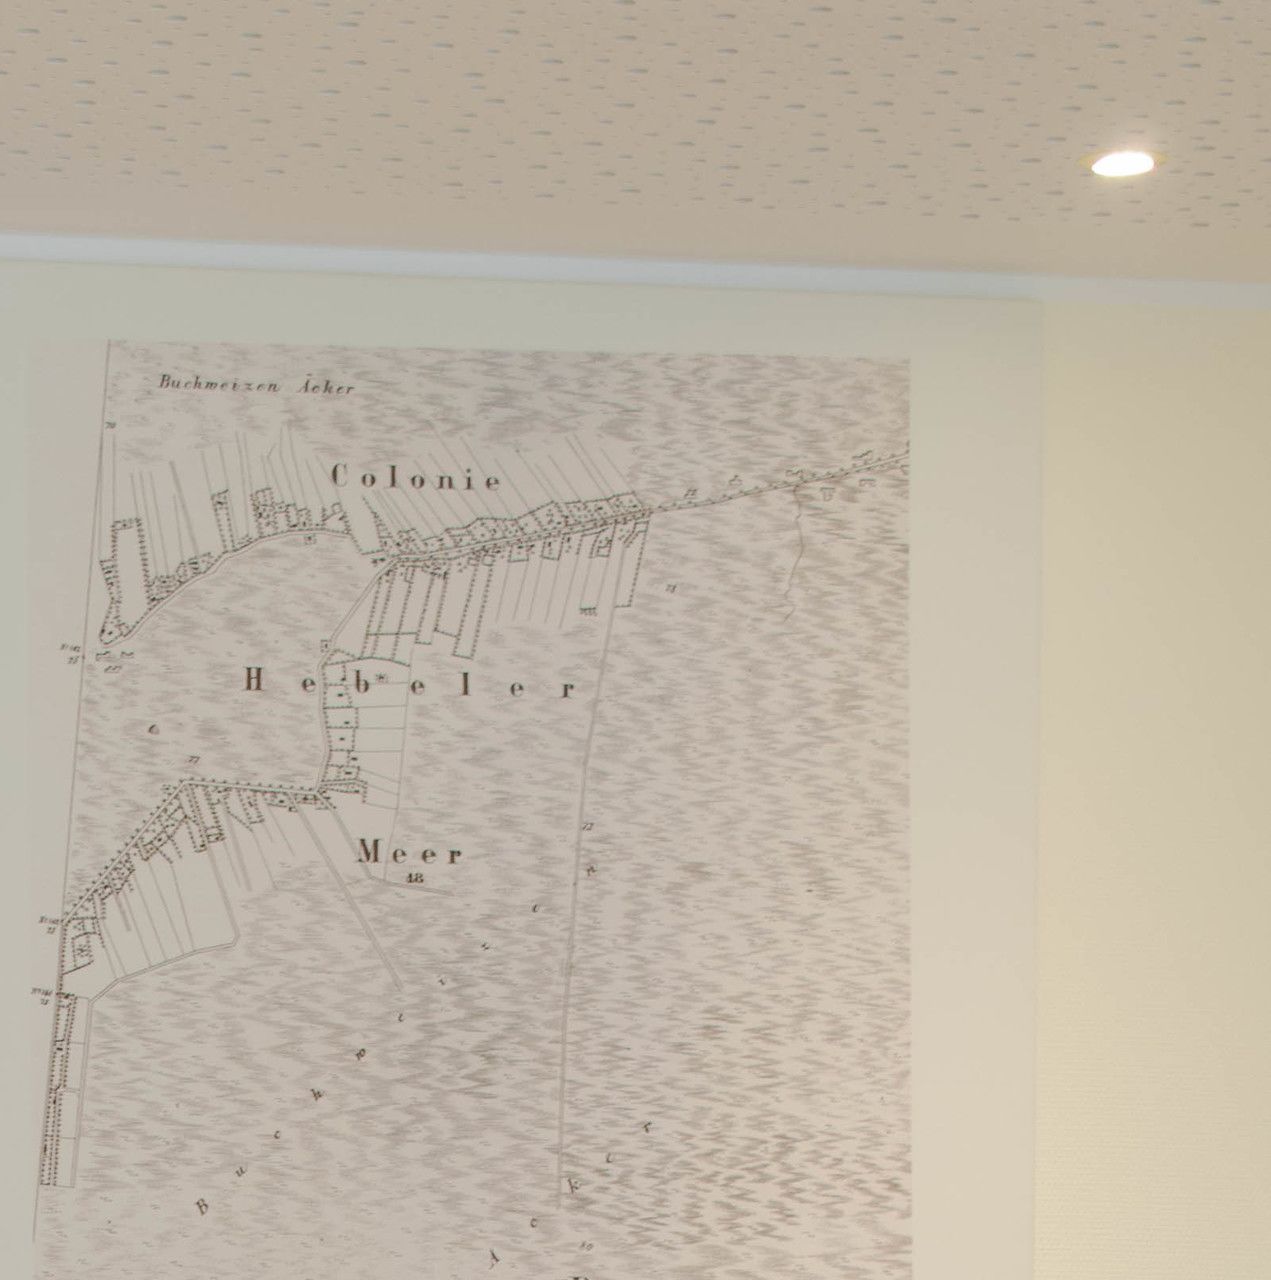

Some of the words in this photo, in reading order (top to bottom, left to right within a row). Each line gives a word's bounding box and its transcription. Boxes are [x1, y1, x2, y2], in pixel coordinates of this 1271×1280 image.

[331, 462, 501, 491] Colonie
[243, 665, 575, 698] Hebeler
[357, 837, 462, 865] Meer
